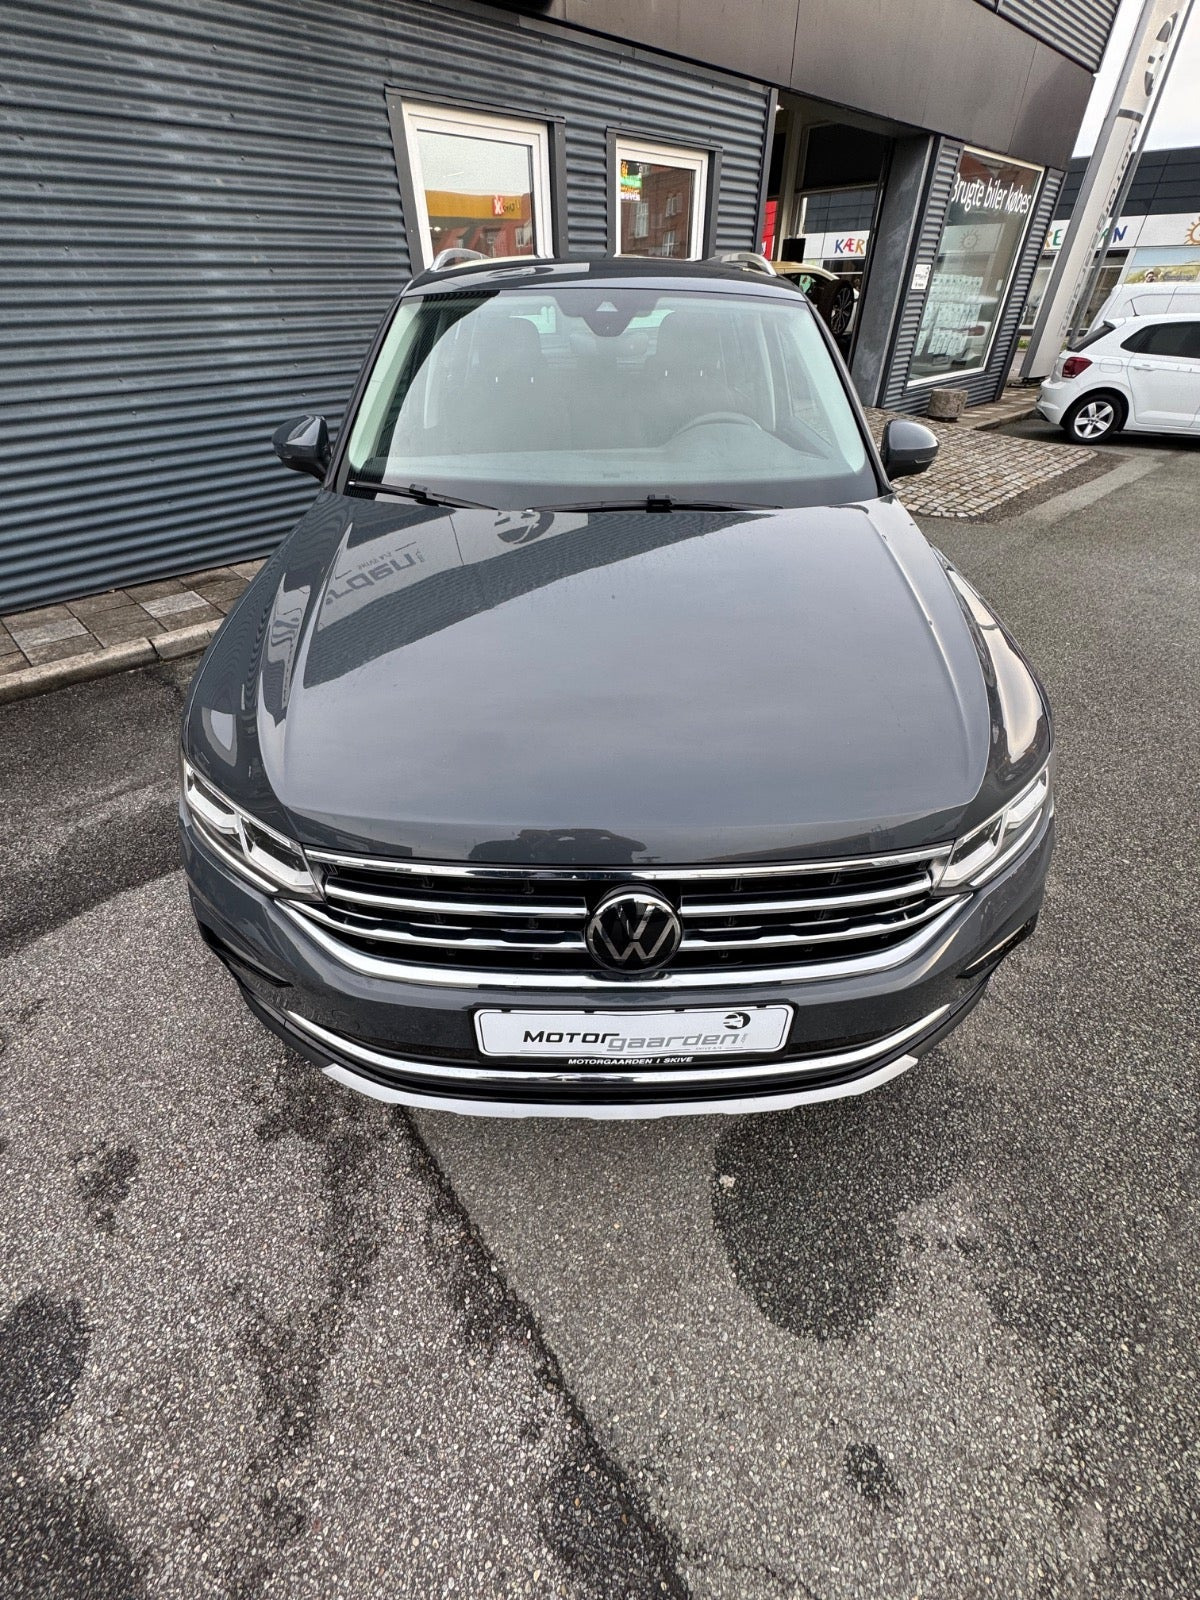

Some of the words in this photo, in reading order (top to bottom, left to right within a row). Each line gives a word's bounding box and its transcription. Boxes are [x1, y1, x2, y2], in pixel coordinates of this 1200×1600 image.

[983, 178, 1007, 210] biler
[1005, 182, 1032, 214] købes
[568, 1058, 653, 1066] MOTORGAARDEN
[663, 1056, 694, 1064] SKIVE
